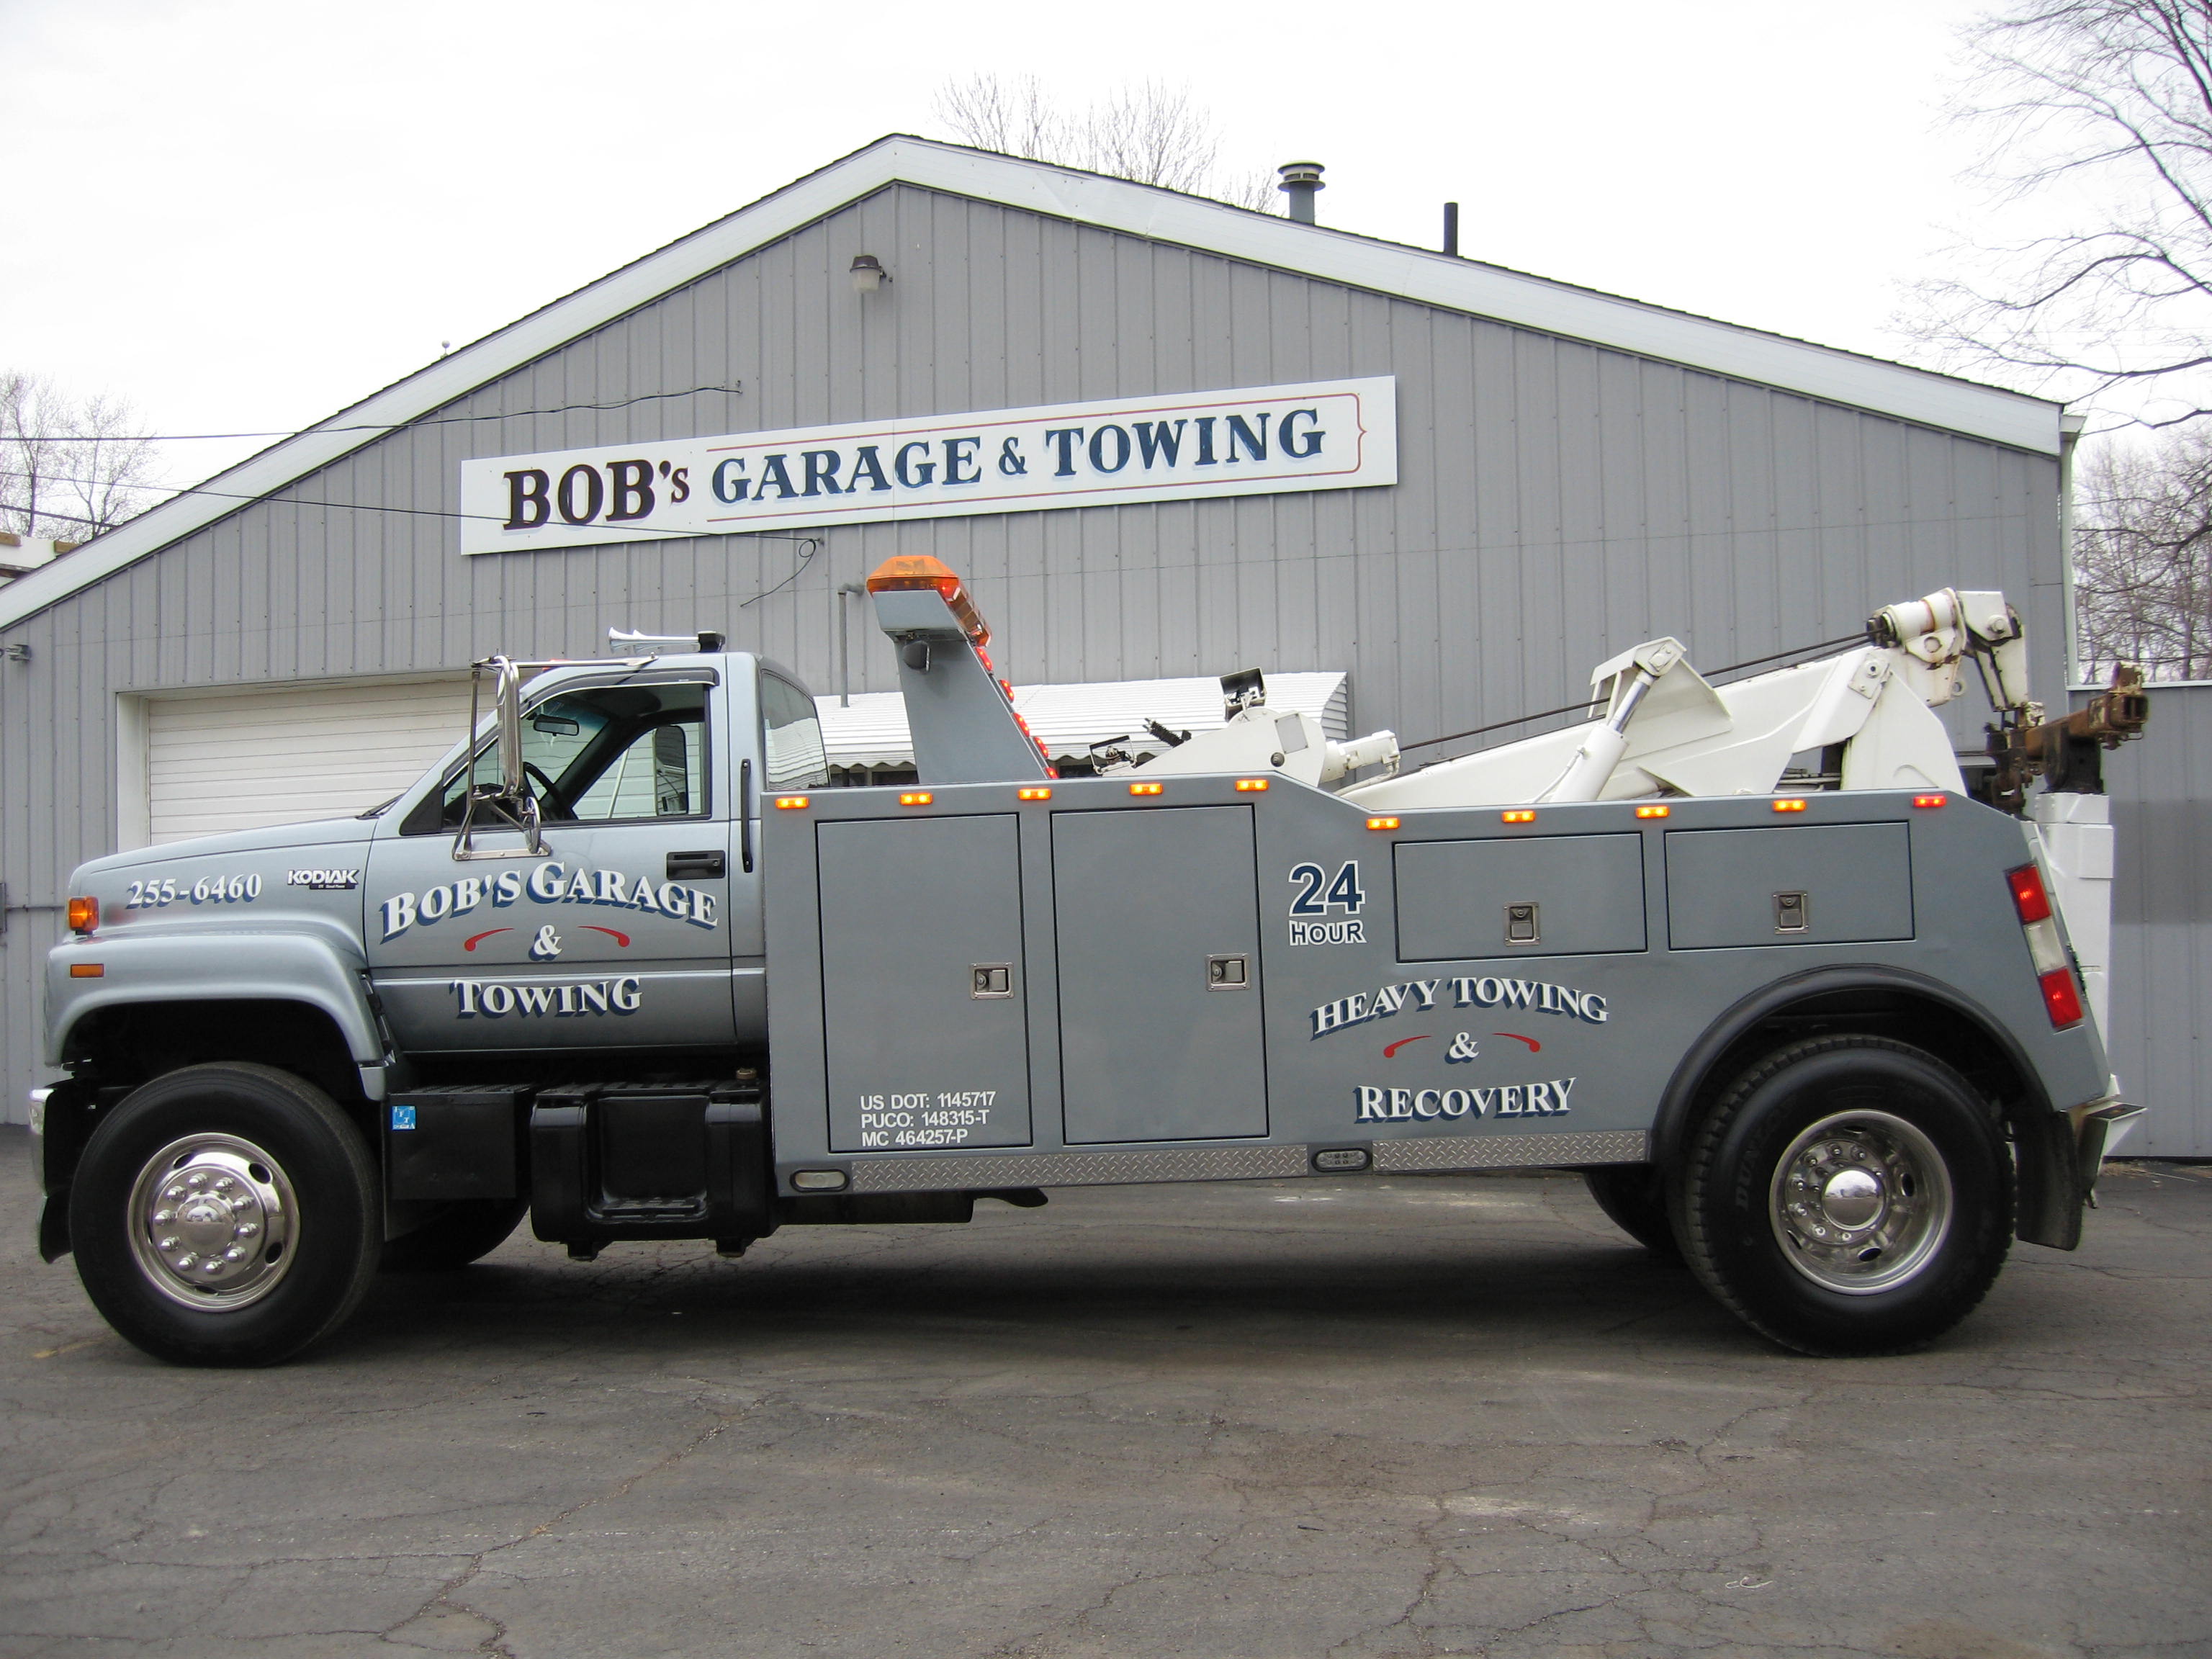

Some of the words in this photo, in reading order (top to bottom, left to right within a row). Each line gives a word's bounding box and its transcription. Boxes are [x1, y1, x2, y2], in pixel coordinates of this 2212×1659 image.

[711, 436, 983, 503] GARAGE
[998, 436, 1028, 476] &
[1046, 408, 1326, 477] TOWING
[128, 873, 262, 907] 255-6460
[287, 869, 359, 886] KODIAK
[1288, 860, 1366, 917] 24
[381, 870, 521, 941] BOB'S
[529, 861, 719, 929] GARAGE
[531, 924, 562, 958] &
[1289, 920, 1367, 946] HOUR
[452, 974, 644, 1016] TOWING
[1312, 979, 1442, 1038] HEAVY
[1449, 976, 1609, 1023] TOWING
[1447, 1031, 1480, 1062] &
[860, 1094, 885, 1110] US
[891, 1093, 930, 1110] DOT:
[937, 1091, 997, 1107] 1145717
[1355, 1077, 1578, 1122] RECOVERY
[861, 1112, 914, 1128] PUCO:
[921, 1109, 990, 1126] 148315-T
[862, 1131, 889, 1146] MC
[895, 1128, 968, 1146] 464257-P
